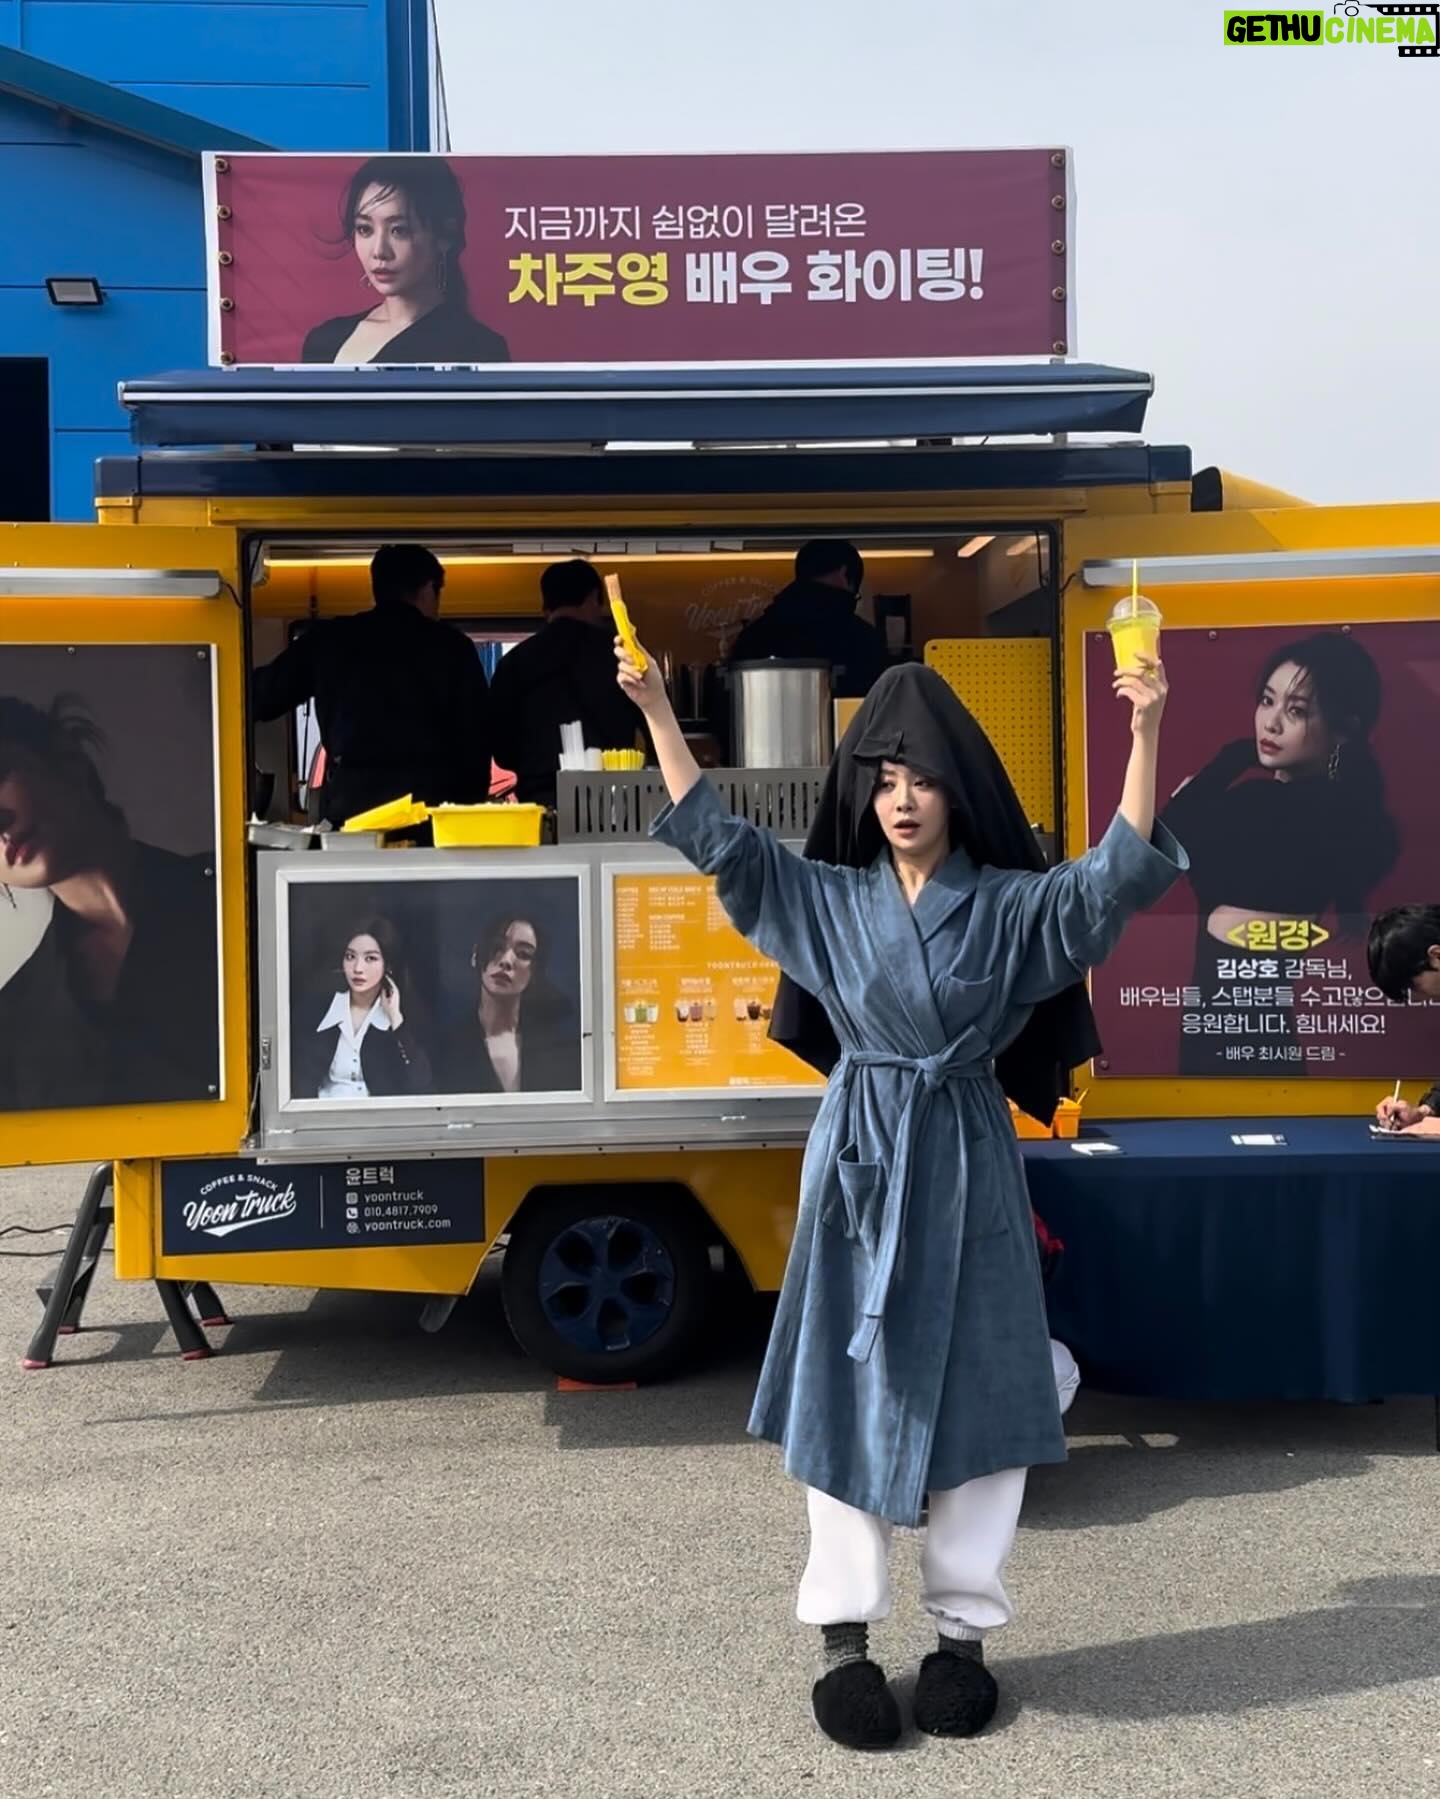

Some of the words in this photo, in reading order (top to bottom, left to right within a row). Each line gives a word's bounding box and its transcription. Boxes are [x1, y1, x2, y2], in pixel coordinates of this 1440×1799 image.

[504, 205, 641, 240] 지금까지
[652, 204, 754, 240] 쉼없이
[765, 202, 867, 239] 달려온
[508, 252, 669, 306] 차주영
[685, 250, 792, 305] 배우
[807, 247, 985, 303] 화이팅!
[1226, 919, 1330, 952] <원경>
[1217, 958, 1280, 979] 김상호
[1284, 958, 1352, 981] 감독님,
[1120, 986, 1207, 1009] 배우님들,
[1211, 986, 1294, 1007] 스탭분들
[1182, 1013, 1291, 1034] 응원합니다.
[1296, 1013, 1386, 1035] 힘내세요!
[1225, 1046, 1255, 1061] 배우
[1259, 1045, 1303, 1061] 최시원
[1306, 1046, 1336, 1061] 드림
[200, 1174, 236, 1195] COFFEE
[237, 1173, 245, 1182] &
[246, 1173, 279, 1191] SNACK
[346, 1166, 394, 1186] 윤트럭
[364, 1189, 424, 1203] yoontruck
[183, 1200, 239, 1231] Yoon
[364, 1204, 438, 1217] 010.4817.7909
[364, 1218, 451, 1232] yoontruck.com
